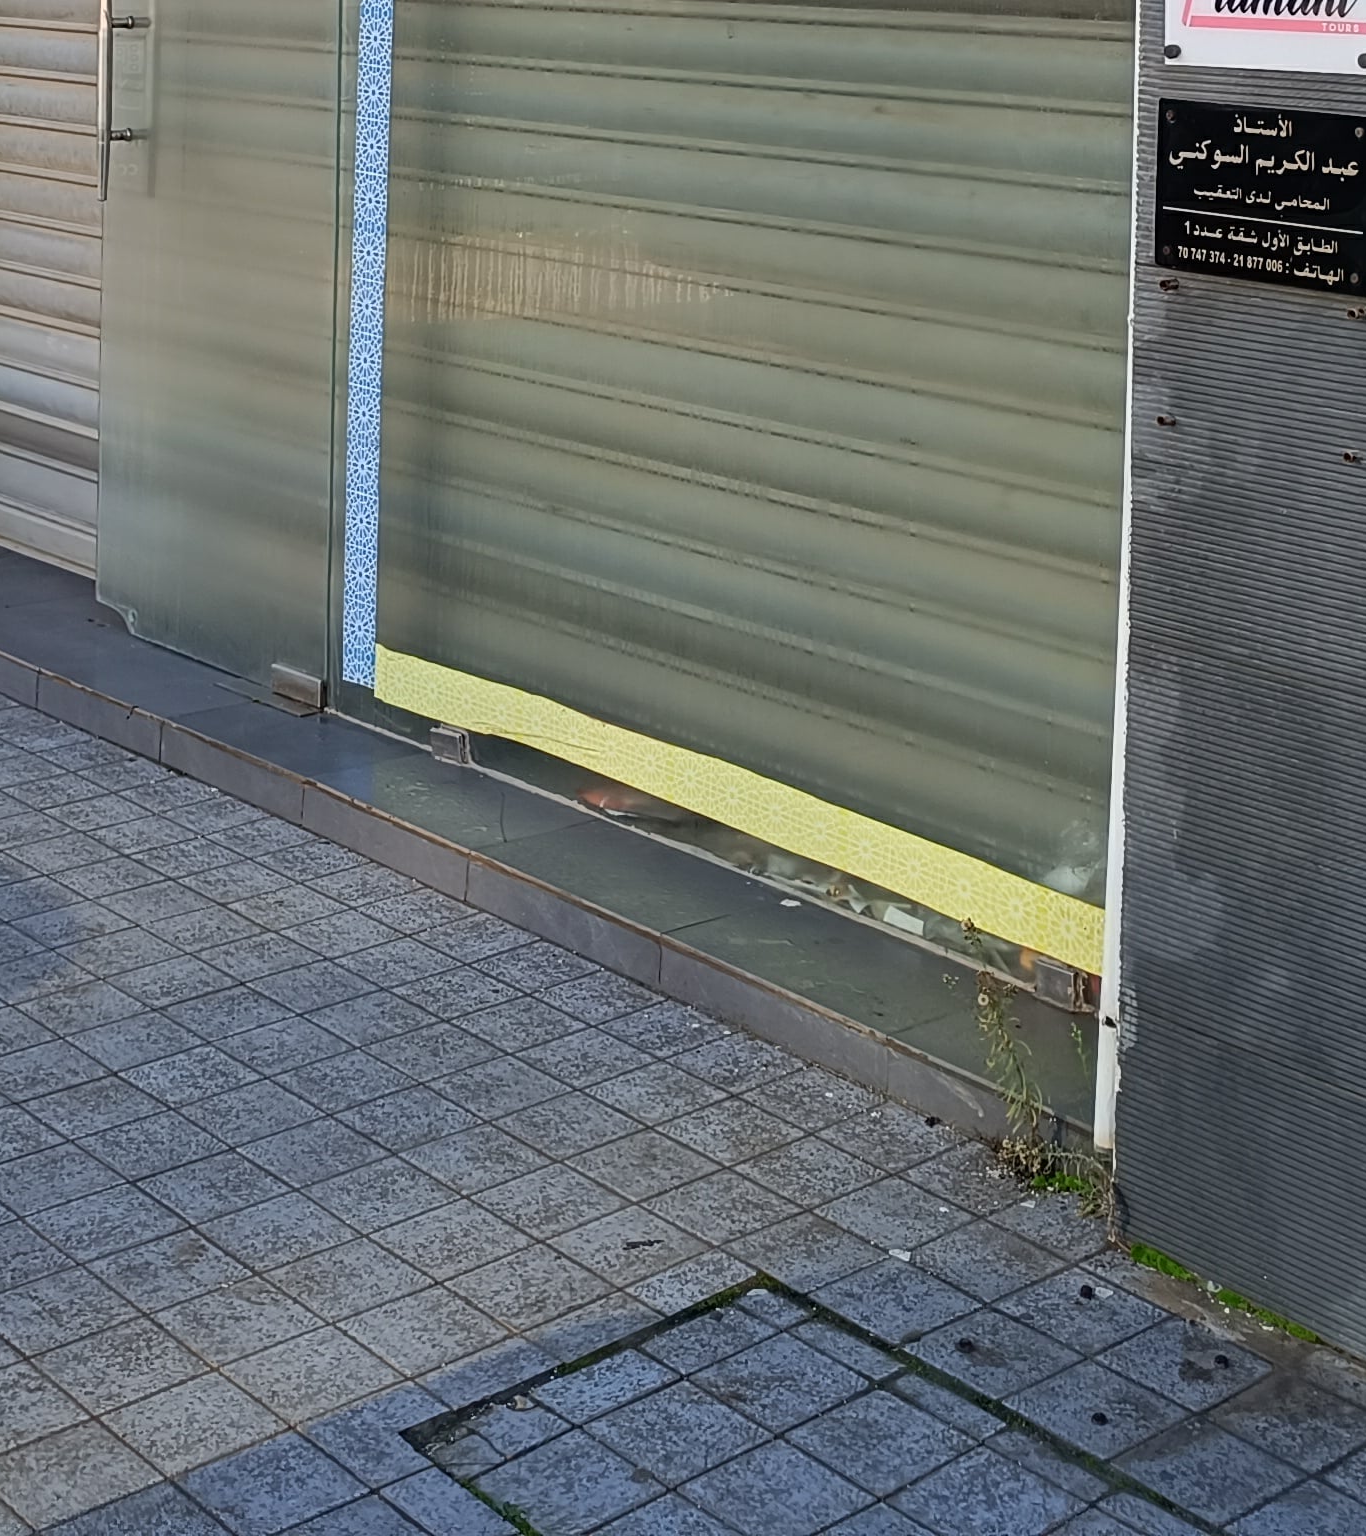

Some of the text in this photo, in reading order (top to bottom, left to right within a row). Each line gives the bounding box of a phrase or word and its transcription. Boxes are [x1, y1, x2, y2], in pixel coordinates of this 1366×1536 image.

[1321, 22, 1360, 33] TOURS
[1233, 113, 1293, 137] الأستاذ
[1169, 139, 1359, 182] عبد الكريم السوكني
[1193, 184, 1242, 201] التعقيب
[1193, 224, 1223, 239] عدد
[1227, 226, 1258, 244] شقة
[1261, 229, 1290, 251] الأول
[1293, 236, 1338, 256] الطابق
[1177, 245, 1189, 259] 70
[1190, 247, 1207, 262] 747
[1209, 250, 1226, 265] 374
[1233, 253, 1244, 267] 21
[1246, 255, 1264, 270] 877
[1265, 258, 1283, 273] 006
[1293, 262, 1344, 286] الهاتف
